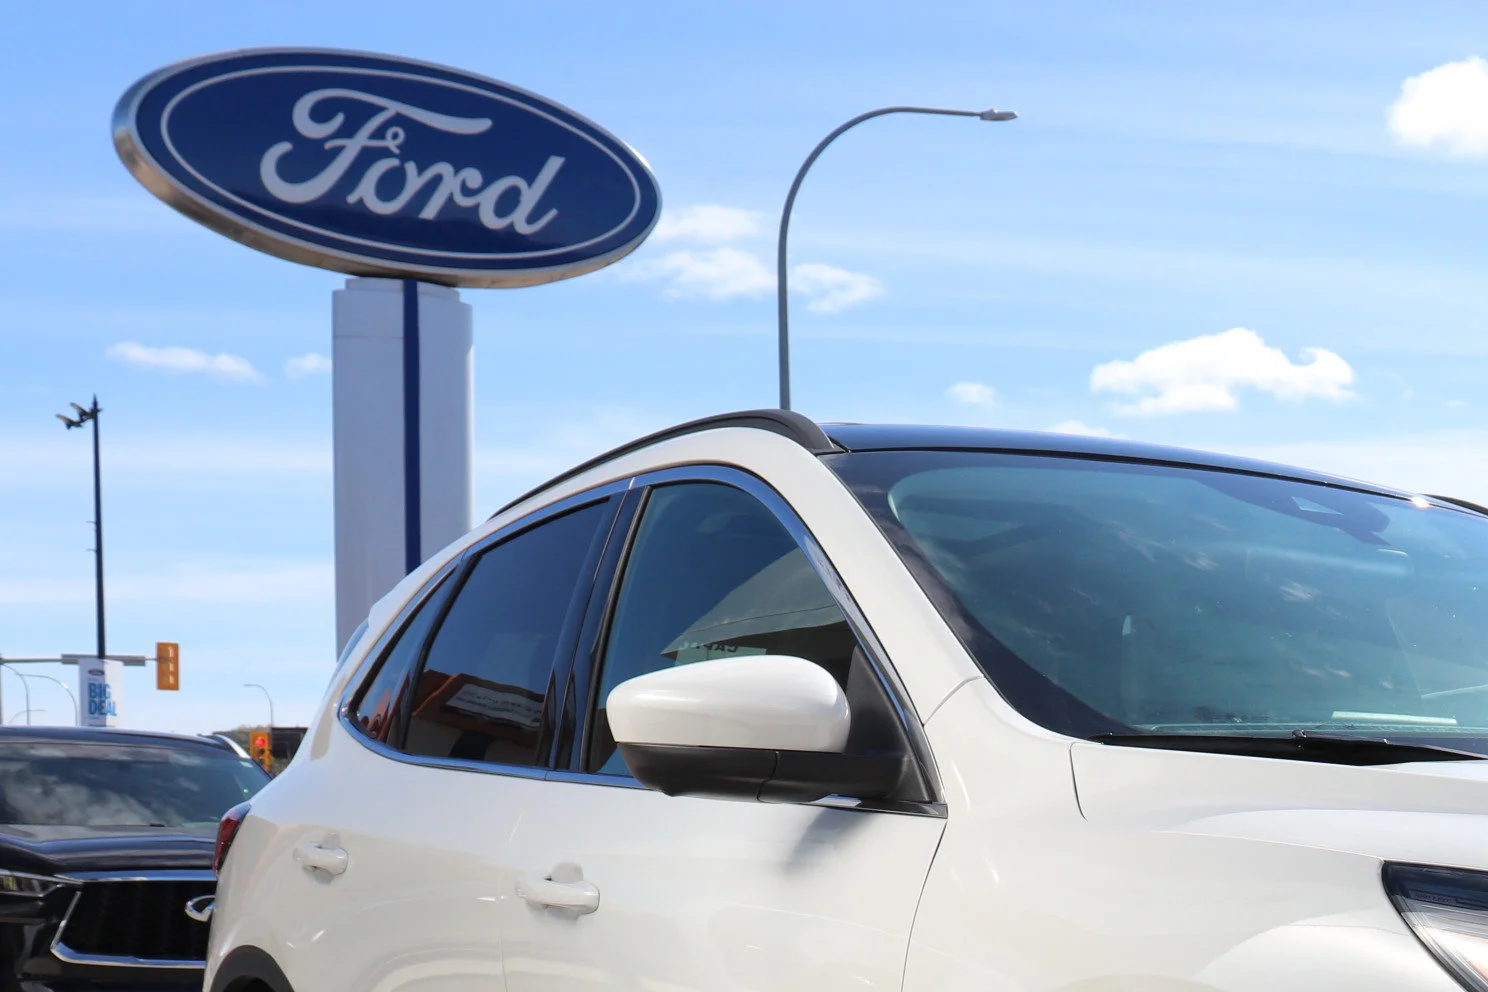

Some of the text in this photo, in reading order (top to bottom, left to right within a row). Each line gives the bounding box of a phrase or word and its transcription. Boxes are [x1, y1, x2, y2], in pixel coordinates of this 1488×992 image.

[260, 88, 566, 235] Ford
[88, 683, 111, 699] BIG
[88, 700, 117, 716] DEAL
